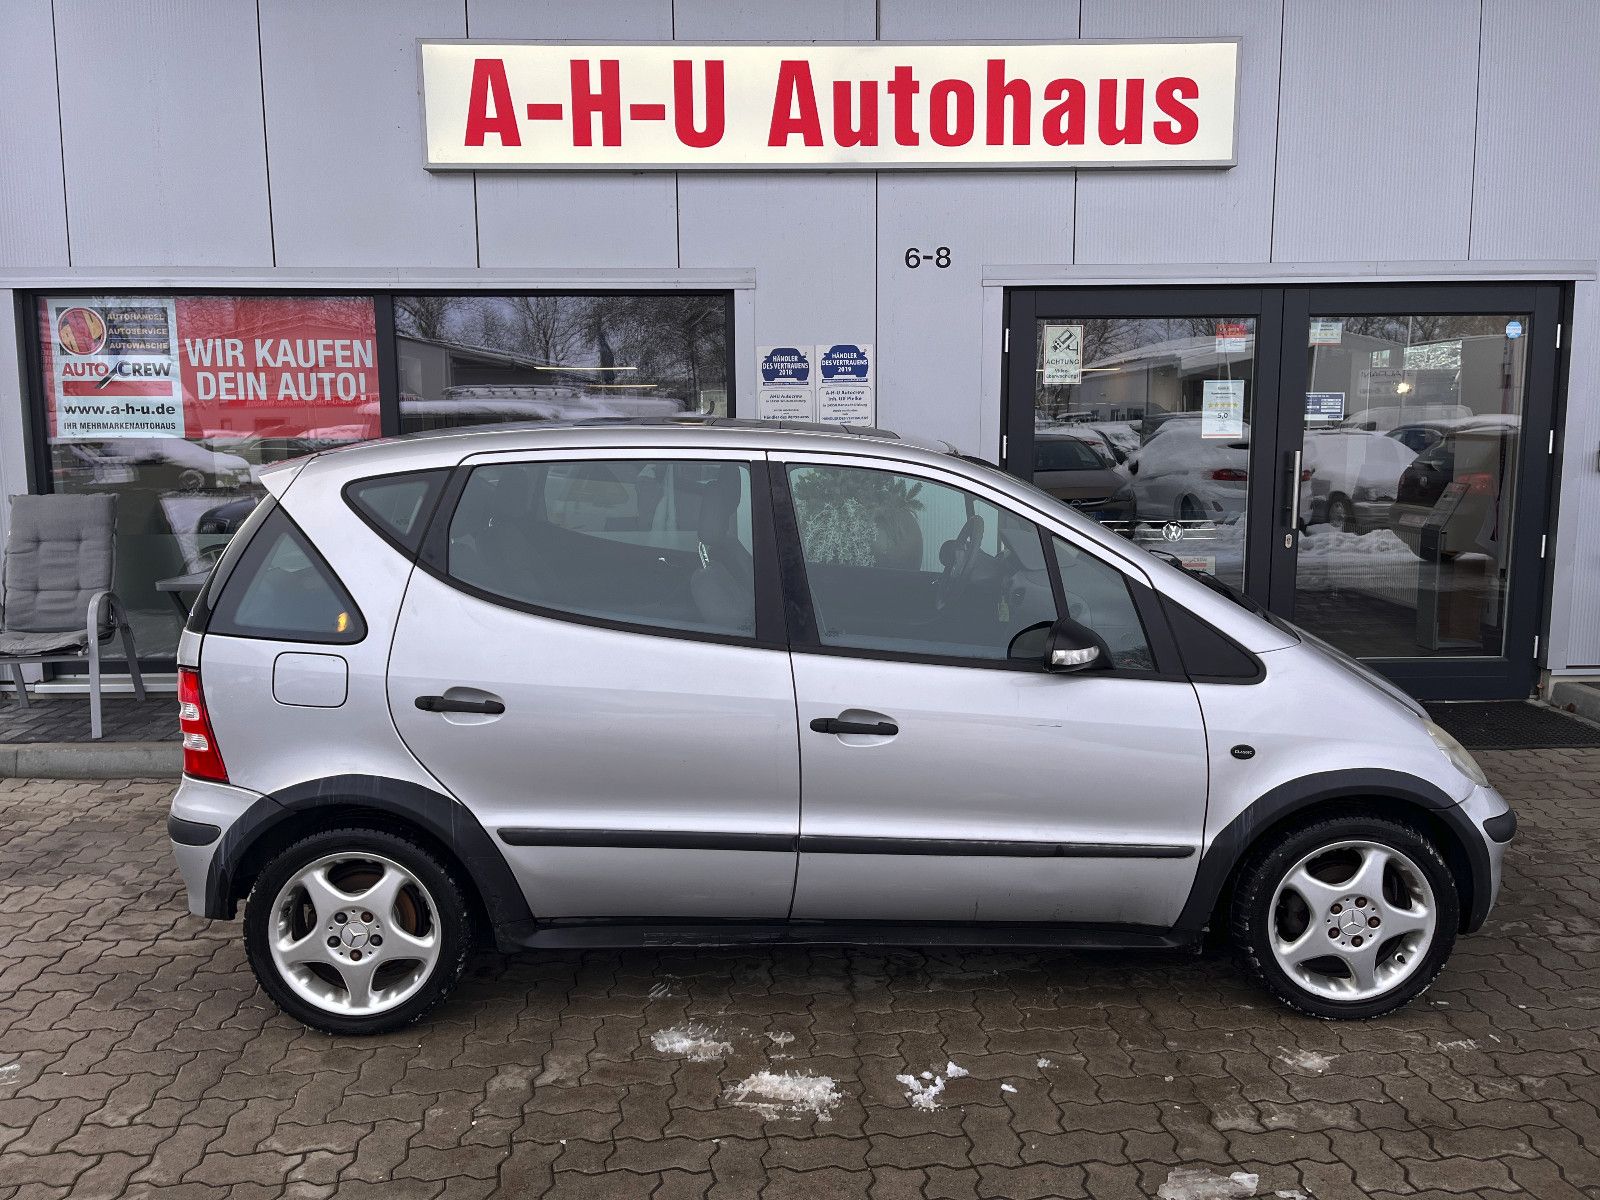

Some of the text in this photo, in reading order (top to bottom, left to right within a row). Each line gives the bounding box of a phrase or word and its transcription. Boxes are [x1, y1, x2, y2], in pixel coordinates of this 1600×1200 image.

[464, 58, 1200, 148] A-H-U Autohaus
[905, 246, 951, 268] 6-8
[184, 338, 373, 368] WIR KAUFEN
[772, 354, 799, 362] HÄNDLER
[196, 371, 367, 401] DEIN AUTO!
[64, 403, 176, 415] www.a-h-u.de
[64, 422, 176, 430] IHR MEHRMARKENAUTOHAUS
